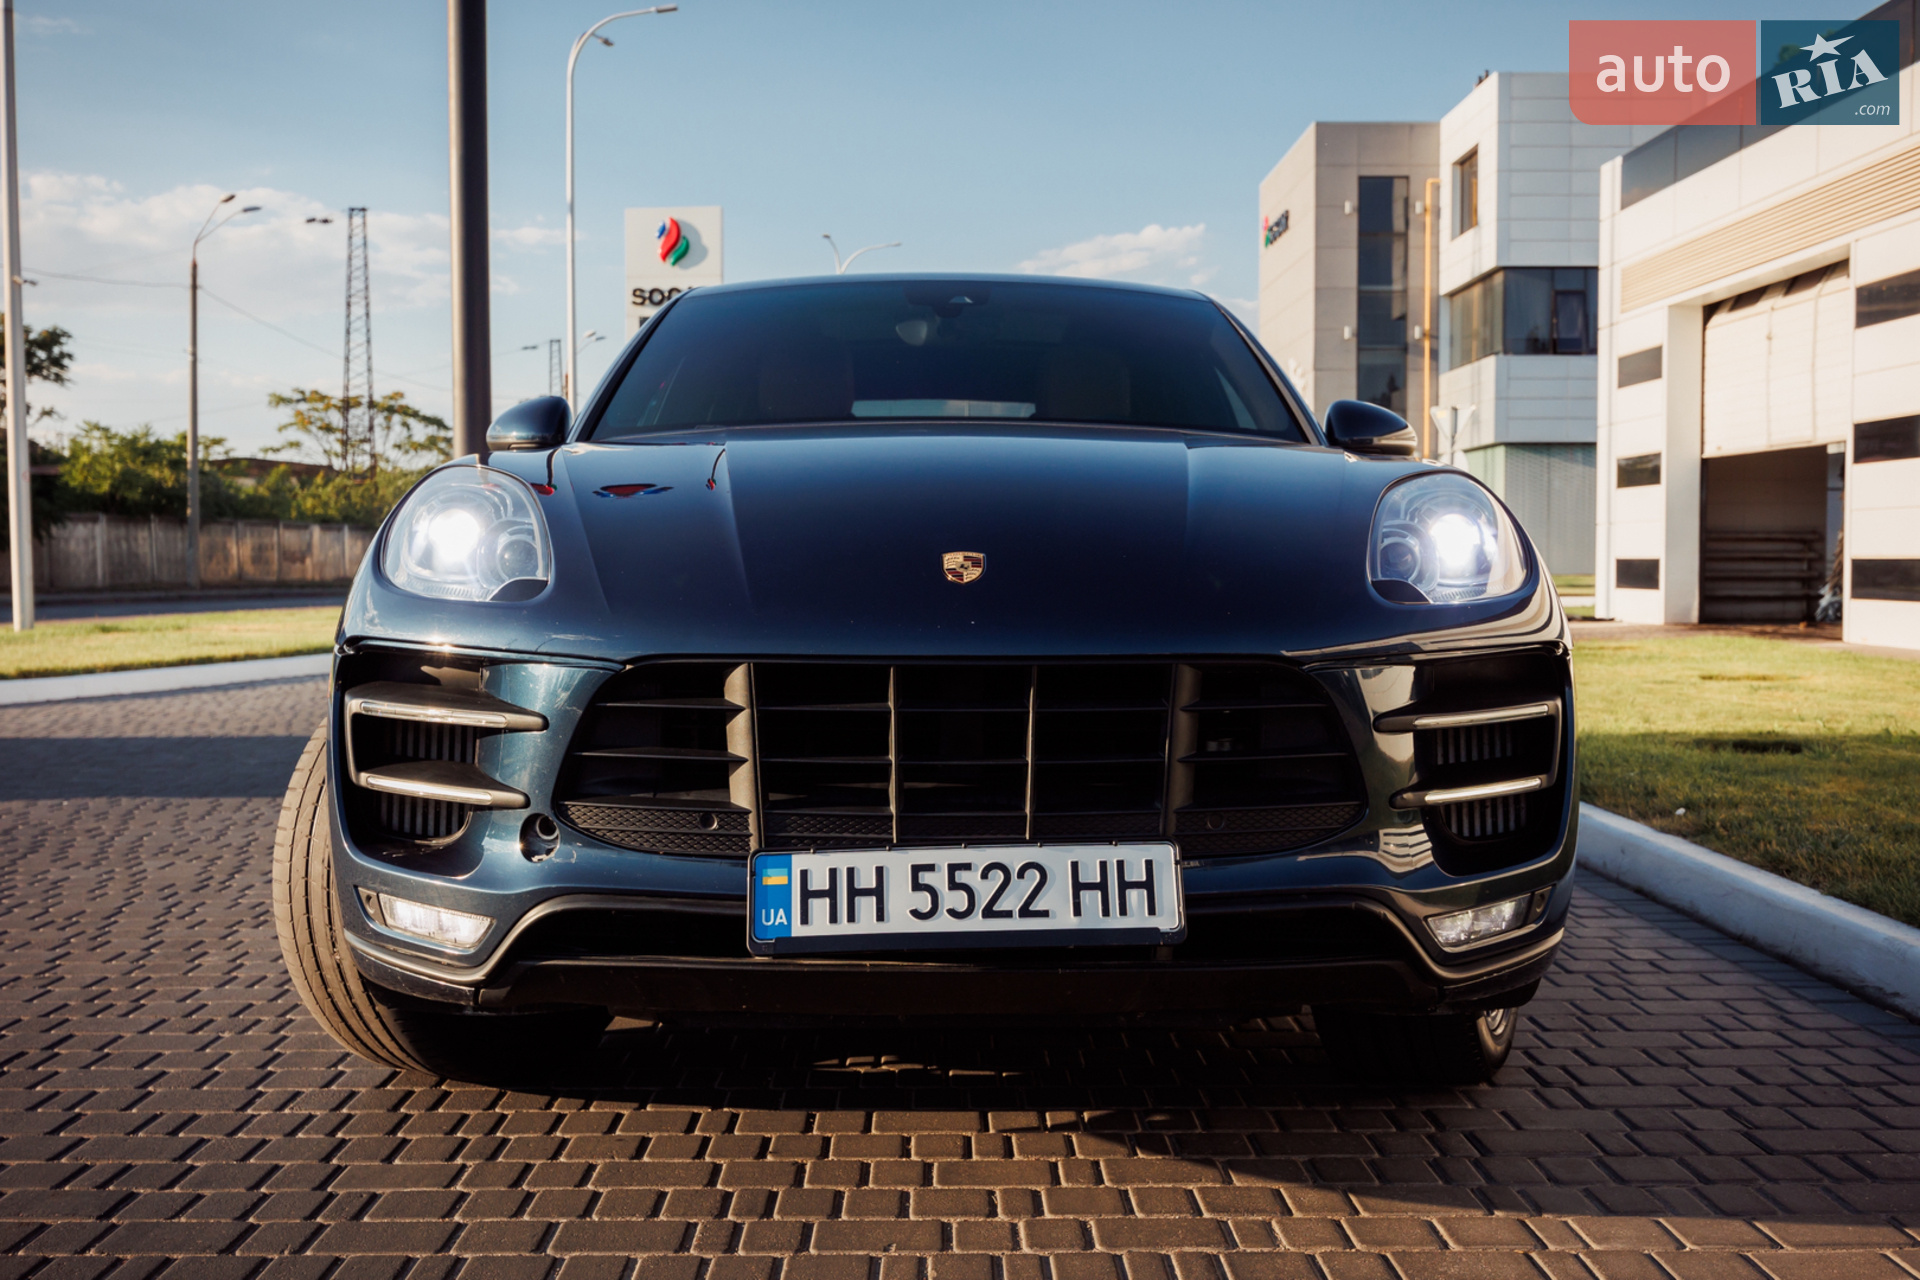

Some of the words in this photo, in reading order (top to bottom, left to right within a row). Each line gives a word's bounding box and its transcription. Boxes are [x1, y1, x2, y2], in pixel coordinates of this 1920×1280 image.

[799, 865, 885, 926] HH
[907, 861, 1050, 920] 5522
[1069, 858, 1157, 918] HH
[761, 907, 788, 926] UA
